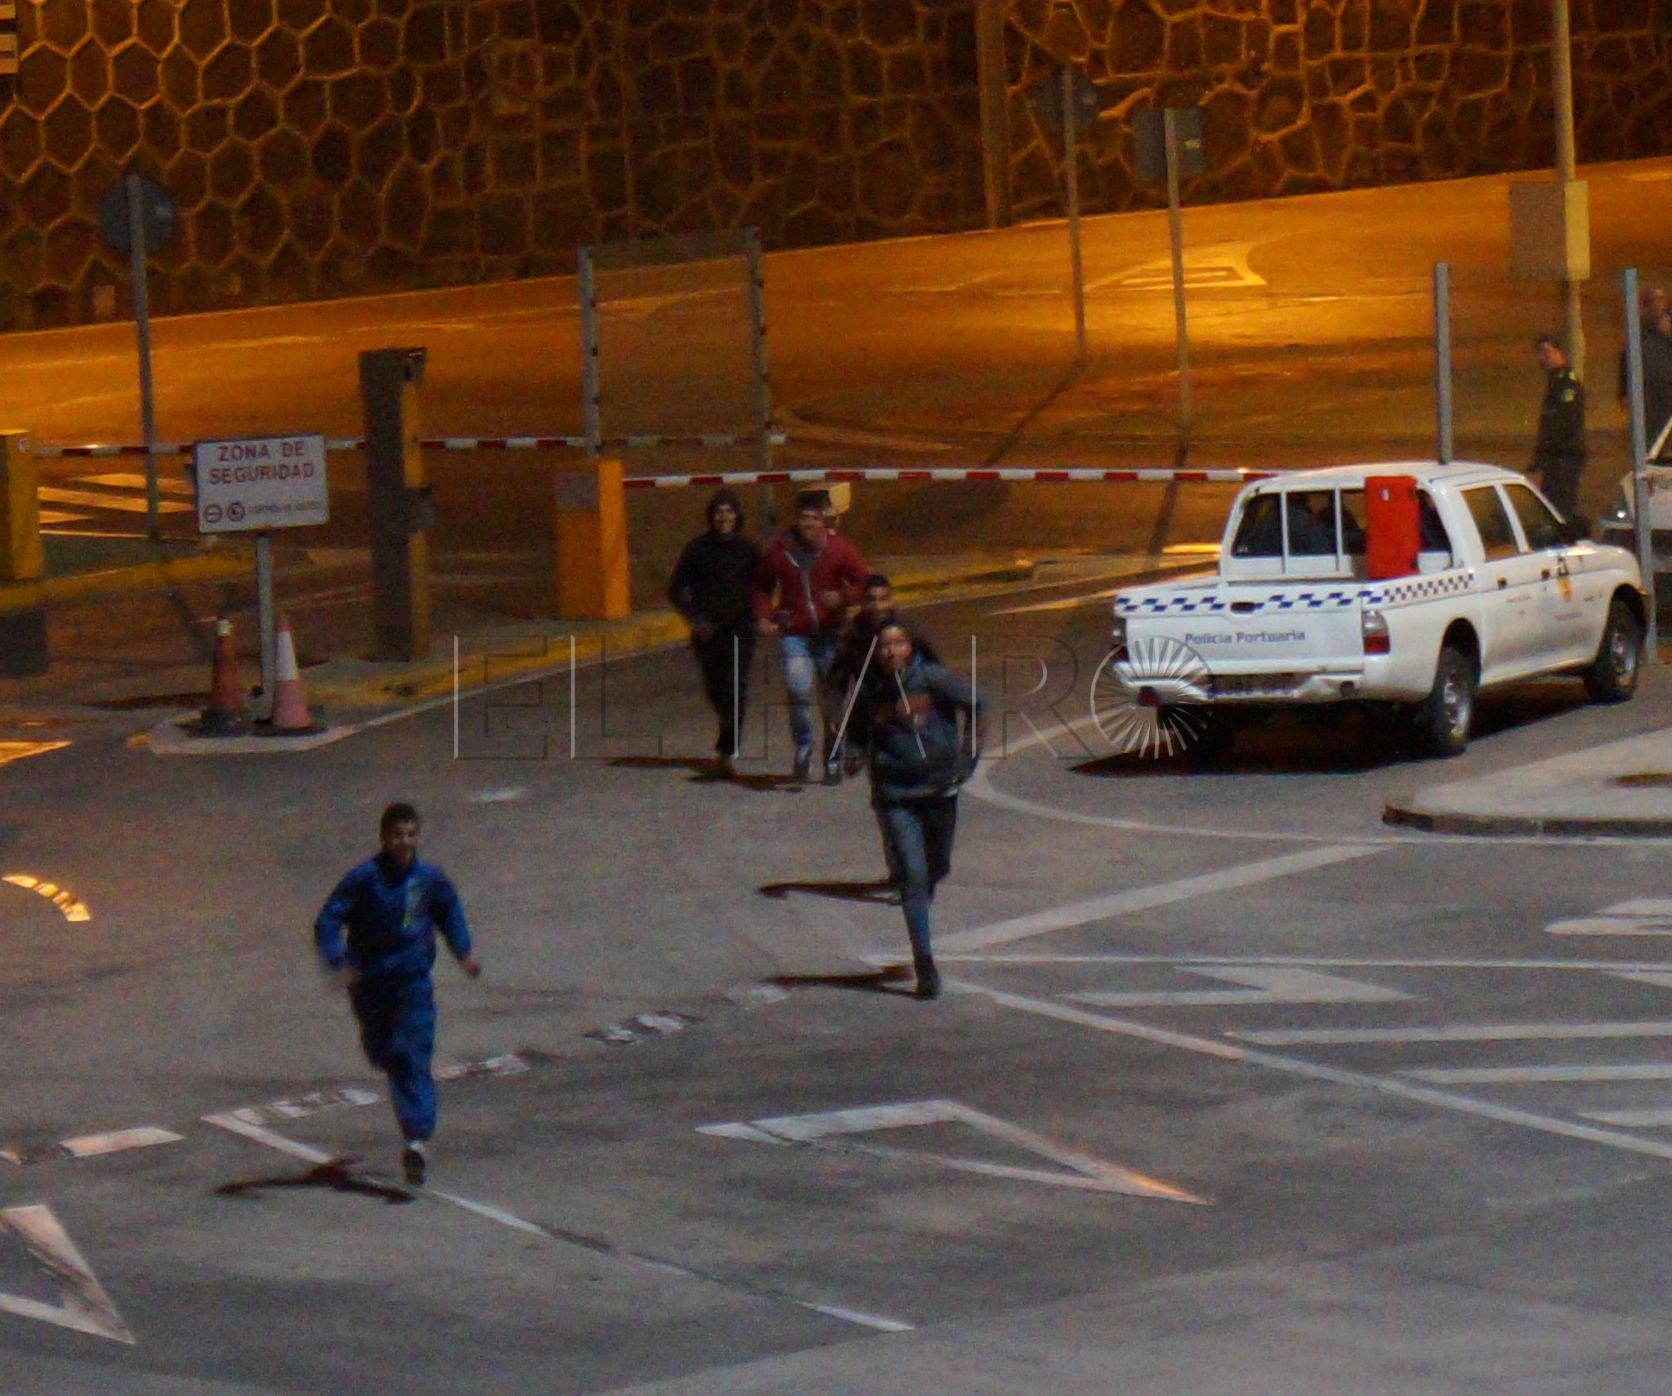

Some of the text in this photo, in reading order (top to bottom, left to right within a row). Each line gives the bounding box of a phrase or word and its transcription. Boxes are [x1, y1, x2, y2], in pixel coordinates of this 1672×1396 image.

[218, 441, 305, 461] ZONA DE
[208, 463, 315, 485] SEGURIDAD
[1236, 630, 1306, 643] Portuaria
